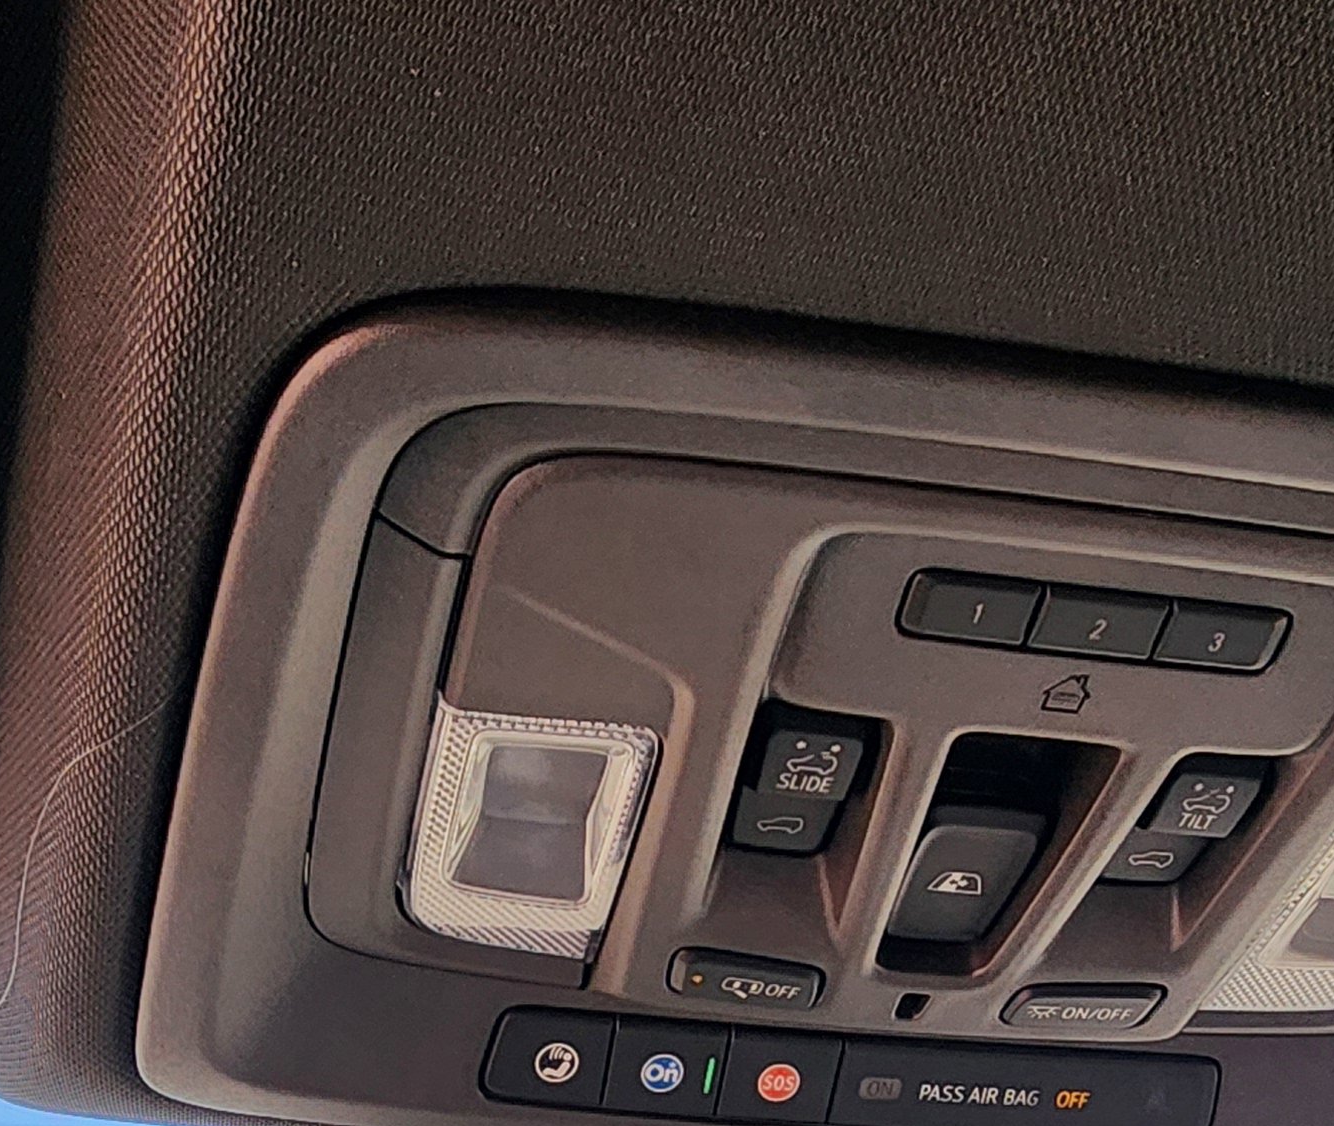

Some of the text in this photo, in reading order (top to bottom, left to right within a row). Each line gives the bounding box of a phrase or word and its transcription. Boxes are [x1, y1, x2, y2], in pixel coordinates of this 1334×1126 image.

[973, 603, 984, 624] 1
[1088, 619, 1107, 640] 2
[1208, 633, 1226, 652] 3
[776, 772, 834, 793] SLIDE
[1178, 812, 1218, 830] TILT
[765, 983, 801, 999] OFF
[1061, 1006, 1133, 1021] ON/OFF
[644, 1062, 679, 1083] On
[762, 1074, 795, 1092] SOS
[868, 1080, 1090, 1109] ON PASS AIR BAG OFF
